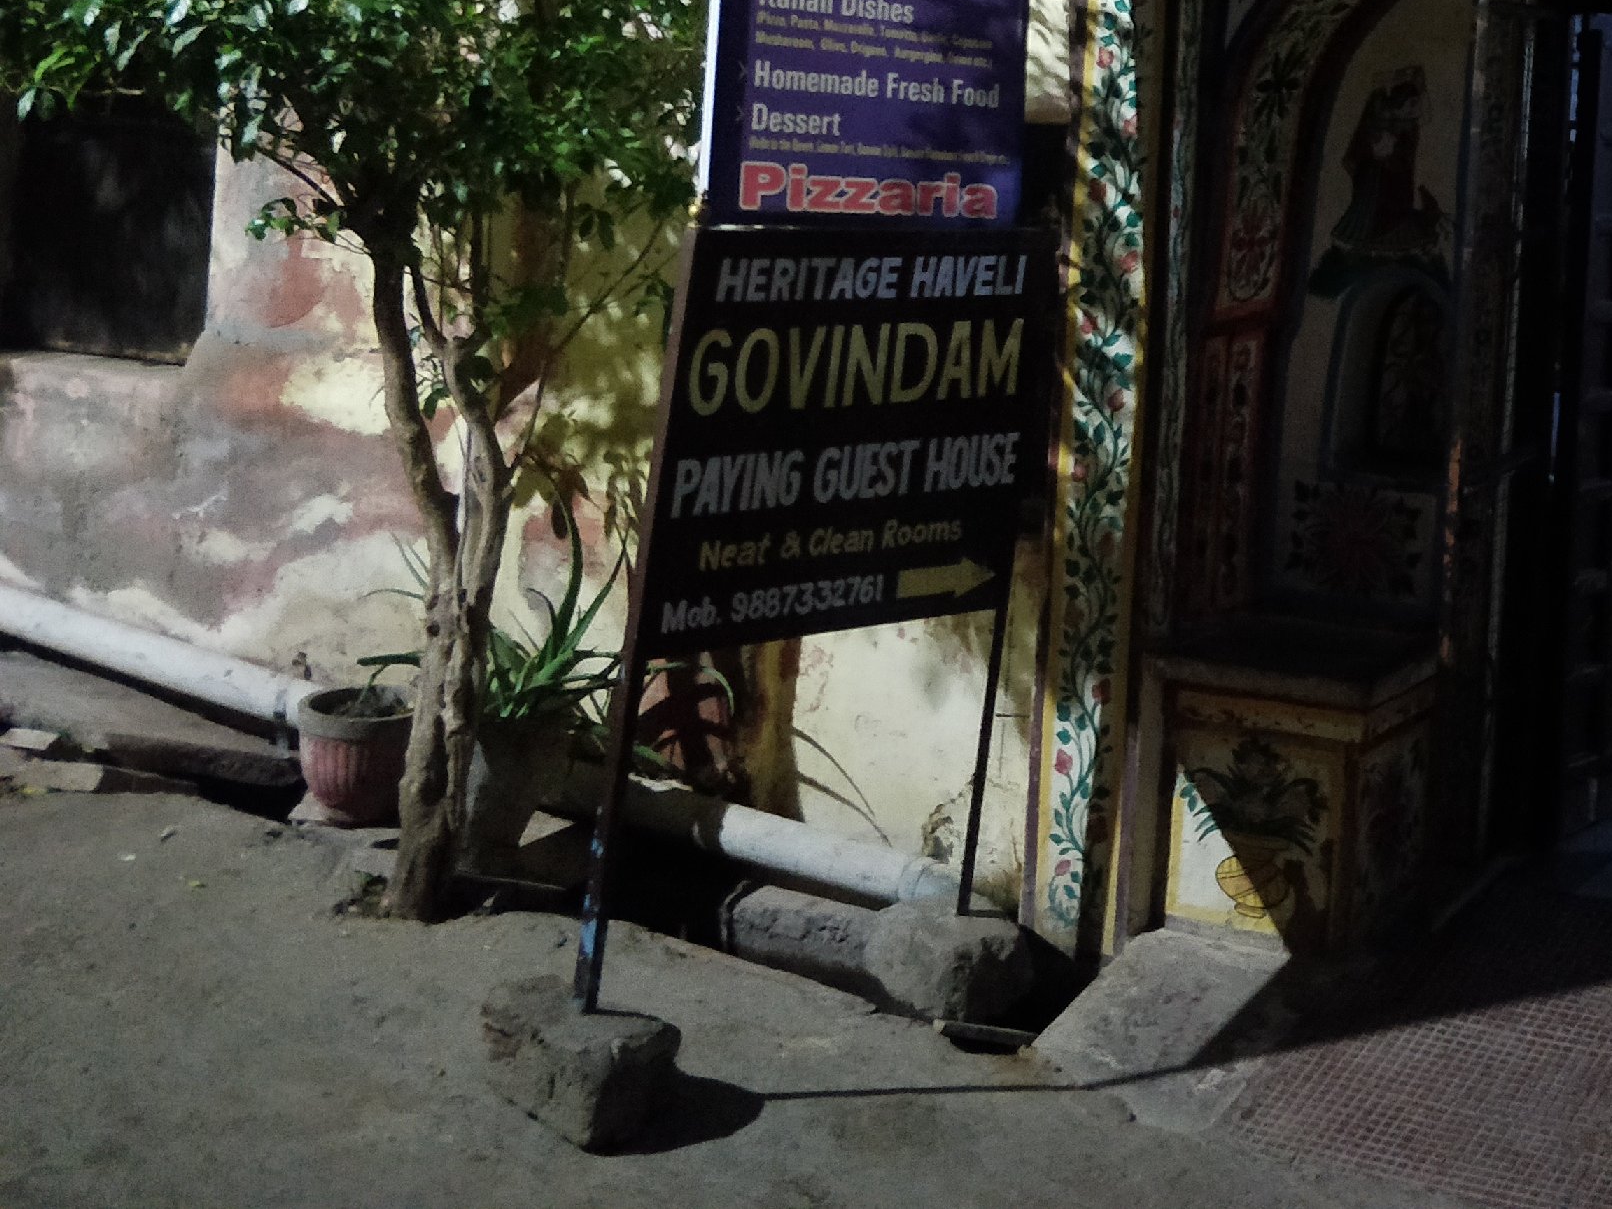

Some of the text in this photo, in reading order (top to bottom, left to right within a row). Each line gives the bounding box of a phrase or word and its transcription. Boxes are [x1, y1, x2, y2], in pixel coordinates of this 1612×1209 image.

[754, 59, 1000, 109] Homemade Fresh Food
[751, 102, 841, 136] Dessert
[738, 161, 998, 219] Pizzaria
[715, 255, 1027, 302] HERITAGE HAVELI
[688, 317, 1024, 416] GOVINDAM
[670, 432, 1020, 519] PAYING GUEST HOUSE
[699, 518, 962, 572] Neat & Clean Rooms
[660, 573, 885, 634] Mob. 9887332761
